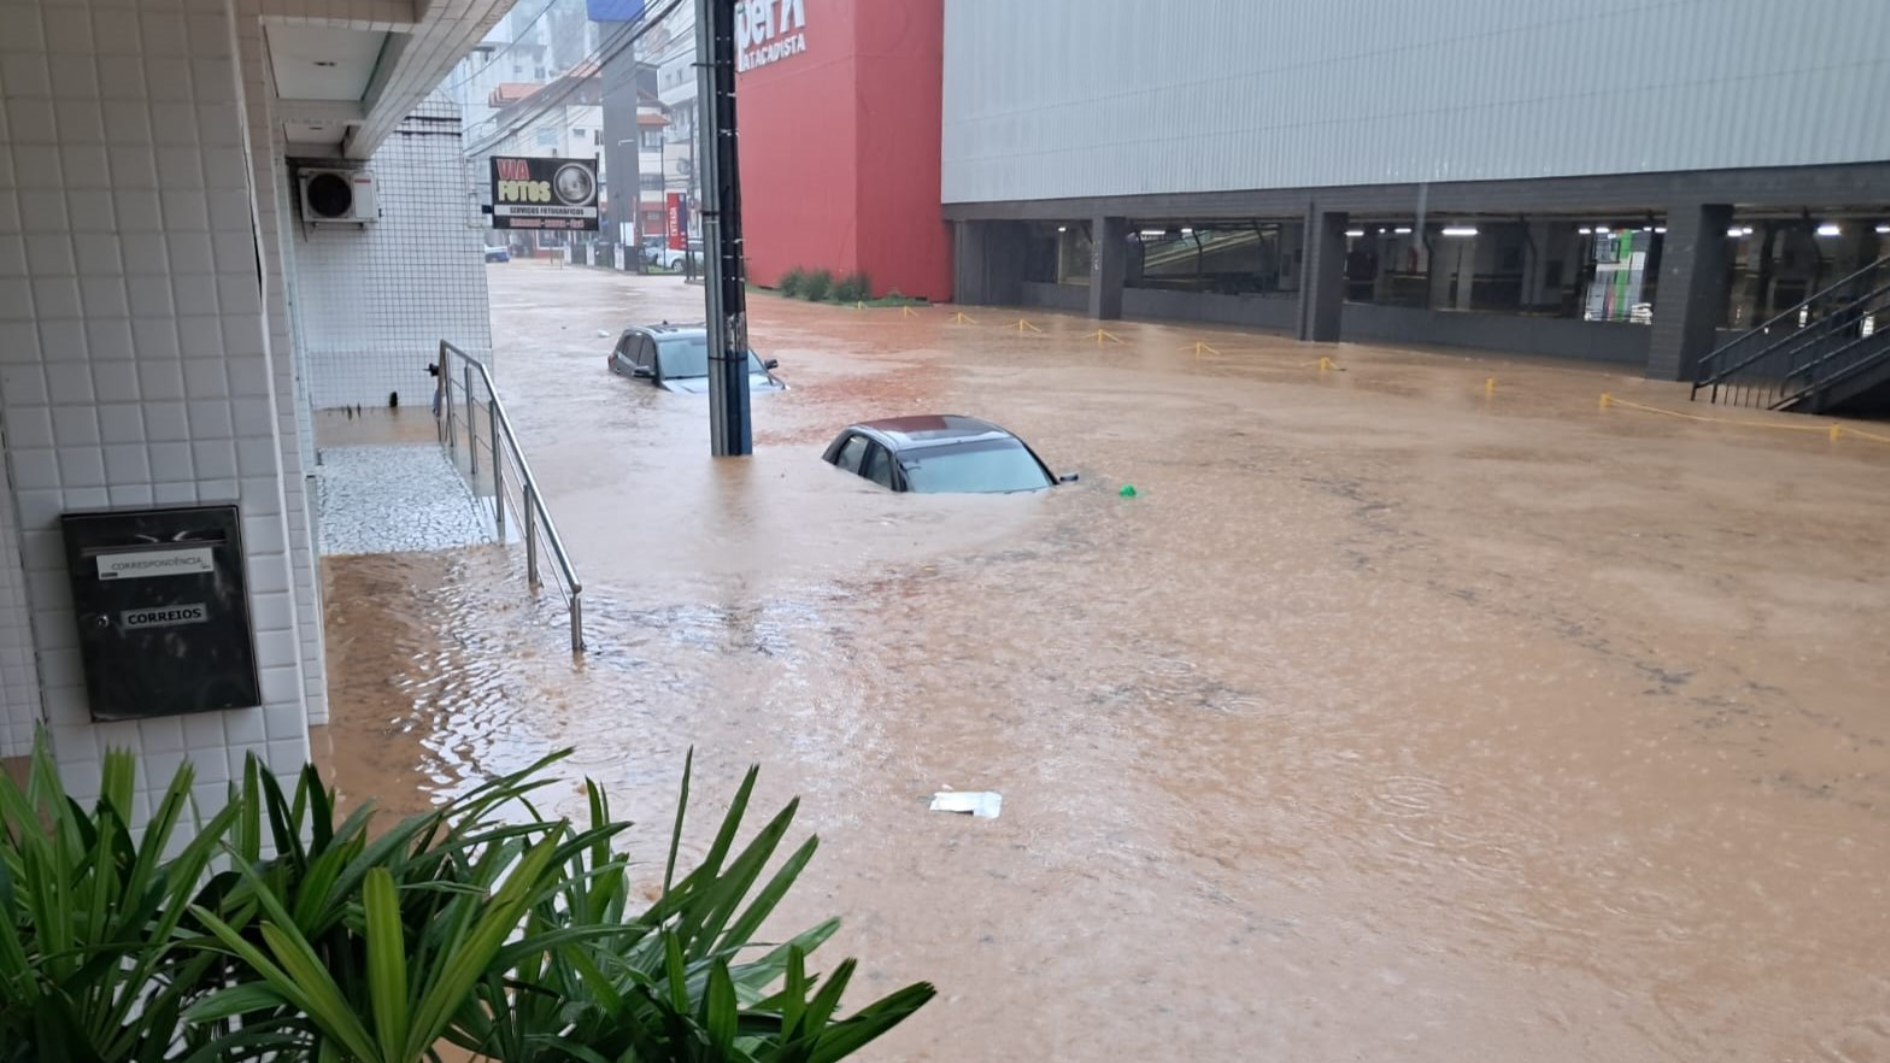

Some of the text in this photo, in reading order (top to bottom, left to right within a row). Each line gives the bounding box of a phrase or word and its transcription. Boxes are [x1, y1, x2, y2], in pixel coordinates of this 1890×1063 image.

[741, 33, 806, 70] ATACADISTA
[497, 158, 529, 180] VIA
[498, 180, 551, 202] FOTOS
[112, 556, 203, 570] CORRESPONDÊNCIA
[128, 608, 202, 625] CORREIOS
